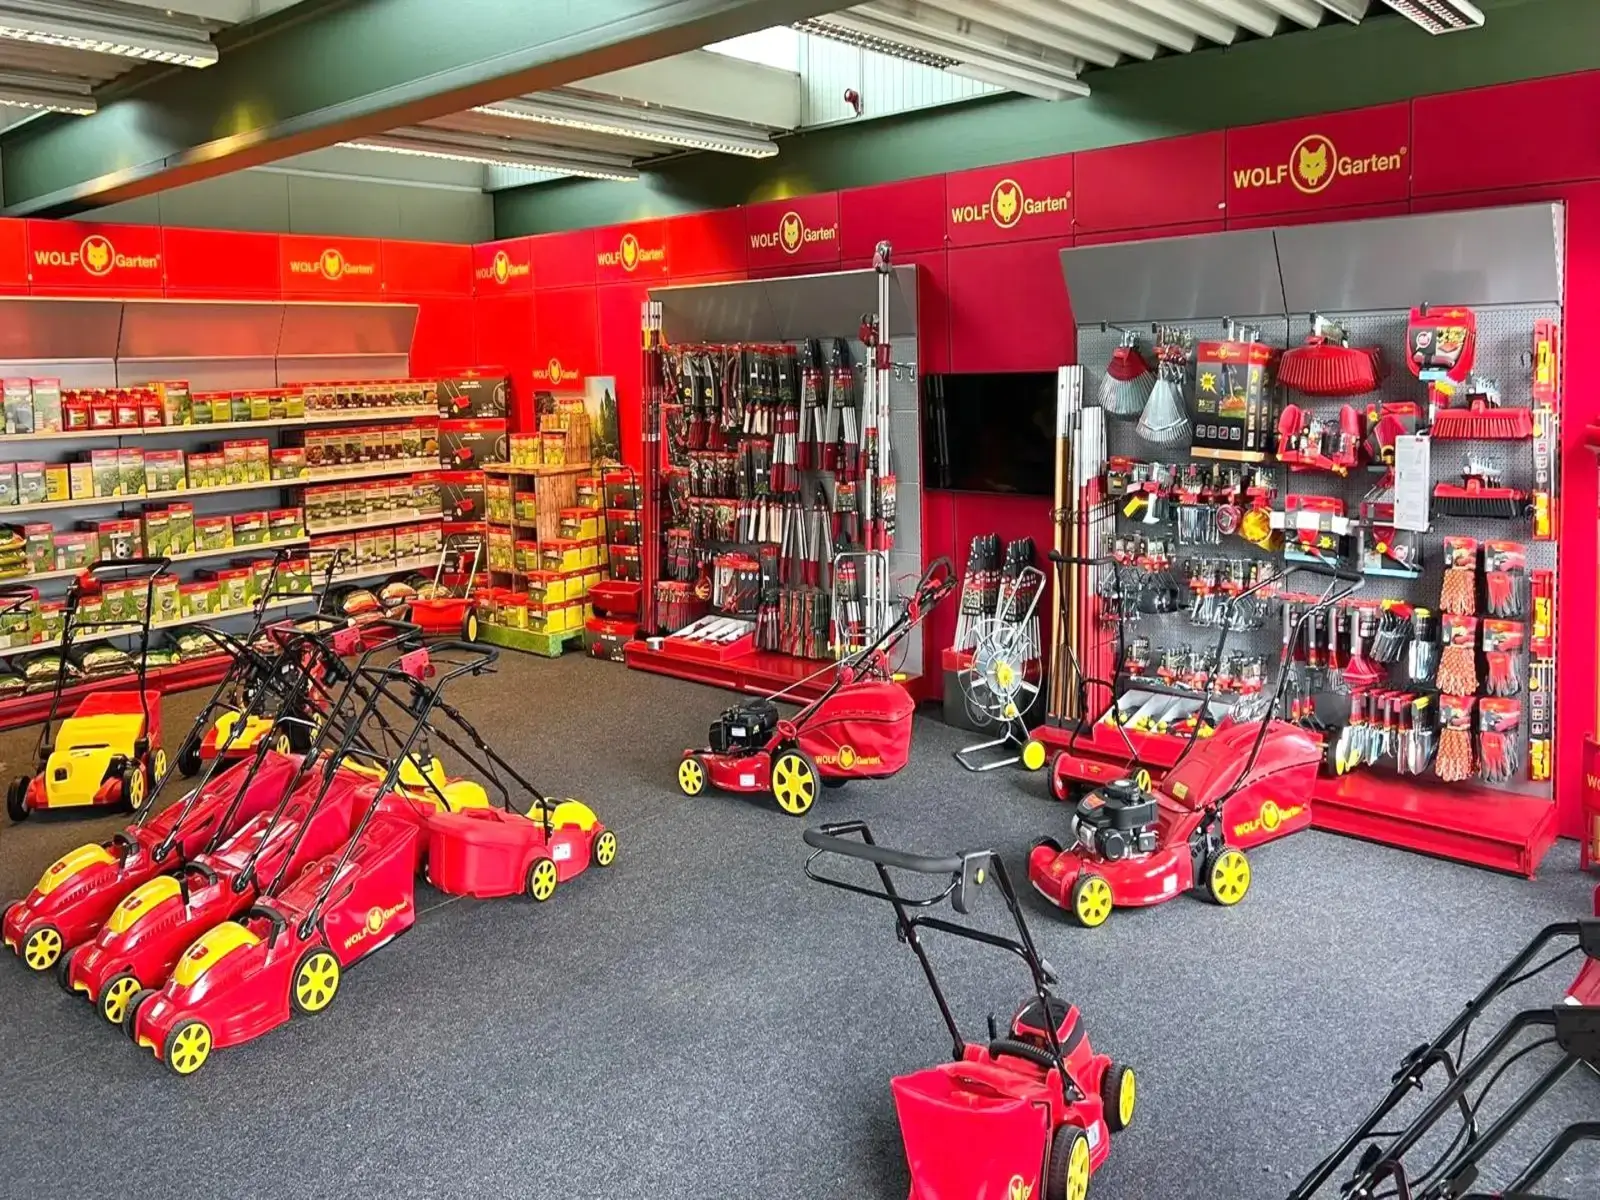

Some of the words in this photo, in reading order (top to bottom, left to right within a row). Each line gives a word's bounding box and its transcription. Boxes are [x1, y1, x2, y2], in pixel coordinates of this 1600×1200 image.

[1233, 164, 1288, 188] WOLF
[951, 204, 989, 223] WOLF
[751, 232, 779, 248] WOLF
[34, 251, 79, 266] WOLF
[290, 261, 320, 273] WOLF
[597, 251, 621, 266] WOLF
[1233, 818, 1261, 837] WOLF
[344, 927, 369, 950] WOLF
